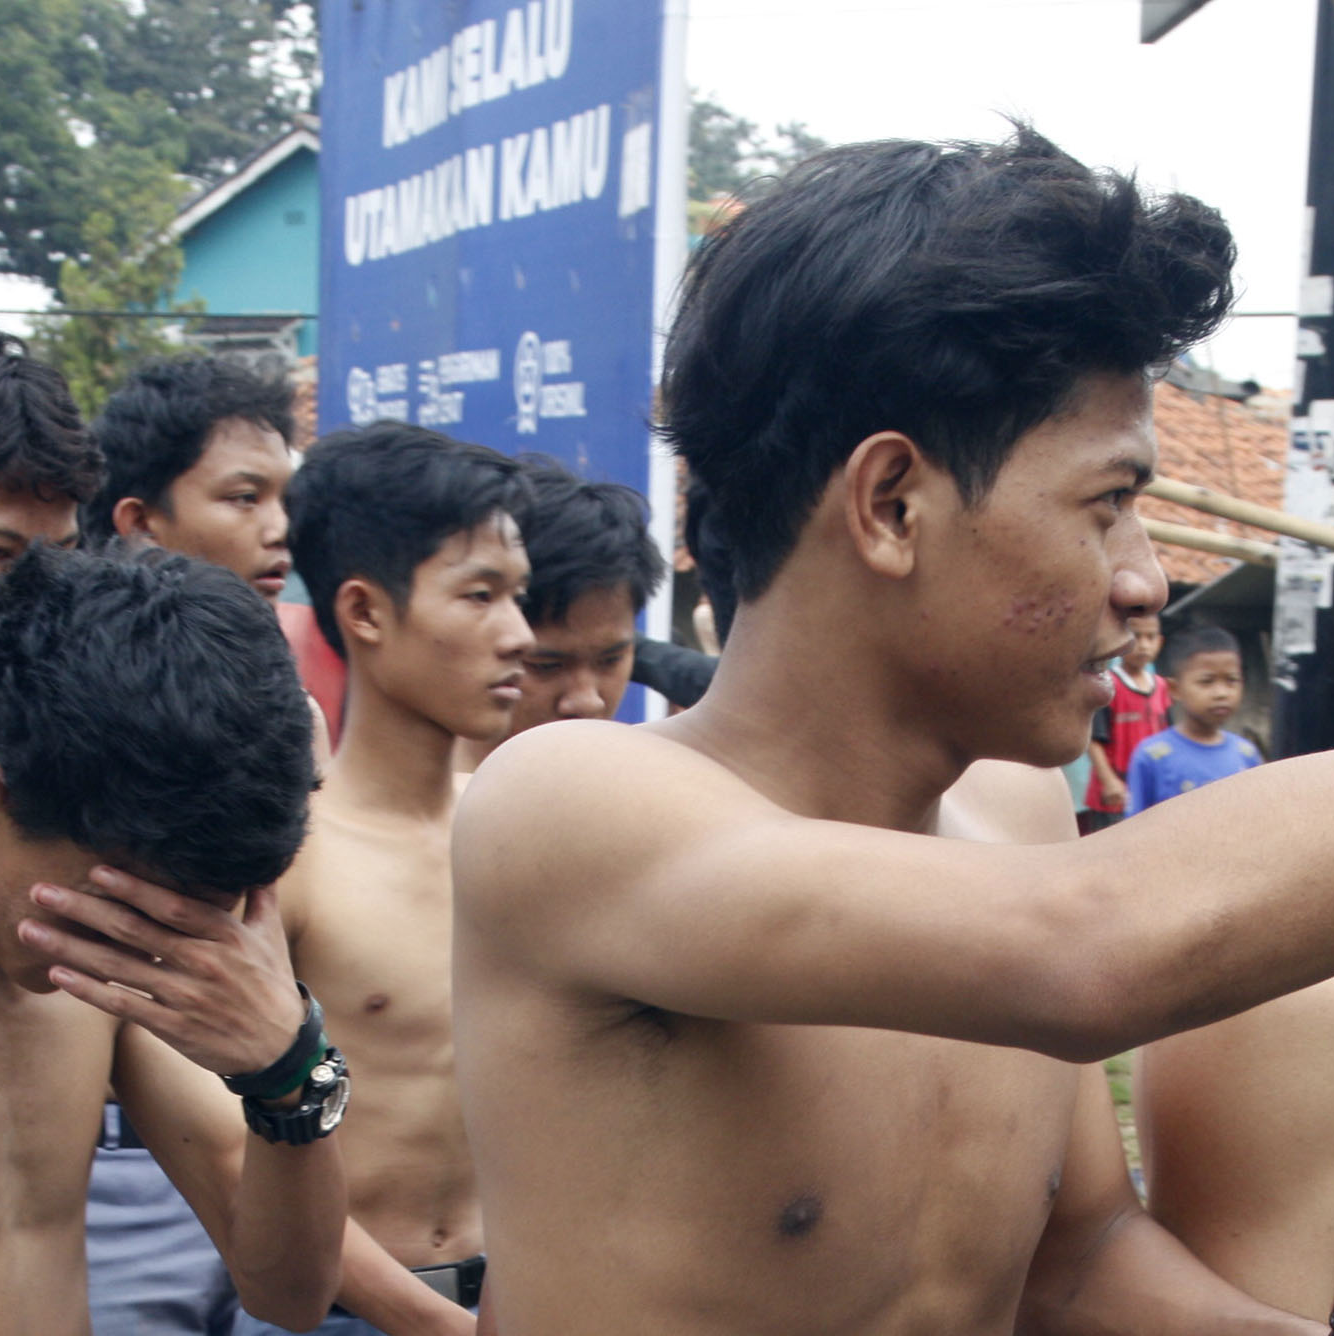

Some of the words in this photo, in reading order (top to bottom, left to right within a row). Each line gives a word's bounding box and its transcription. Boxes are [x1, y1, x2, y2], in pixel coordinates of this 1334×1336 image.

[450, 0, 574, 116] SELALU
[344, 144, 494, 267] UTAMAKAN
[498, 103, 612, 222] KAMU
